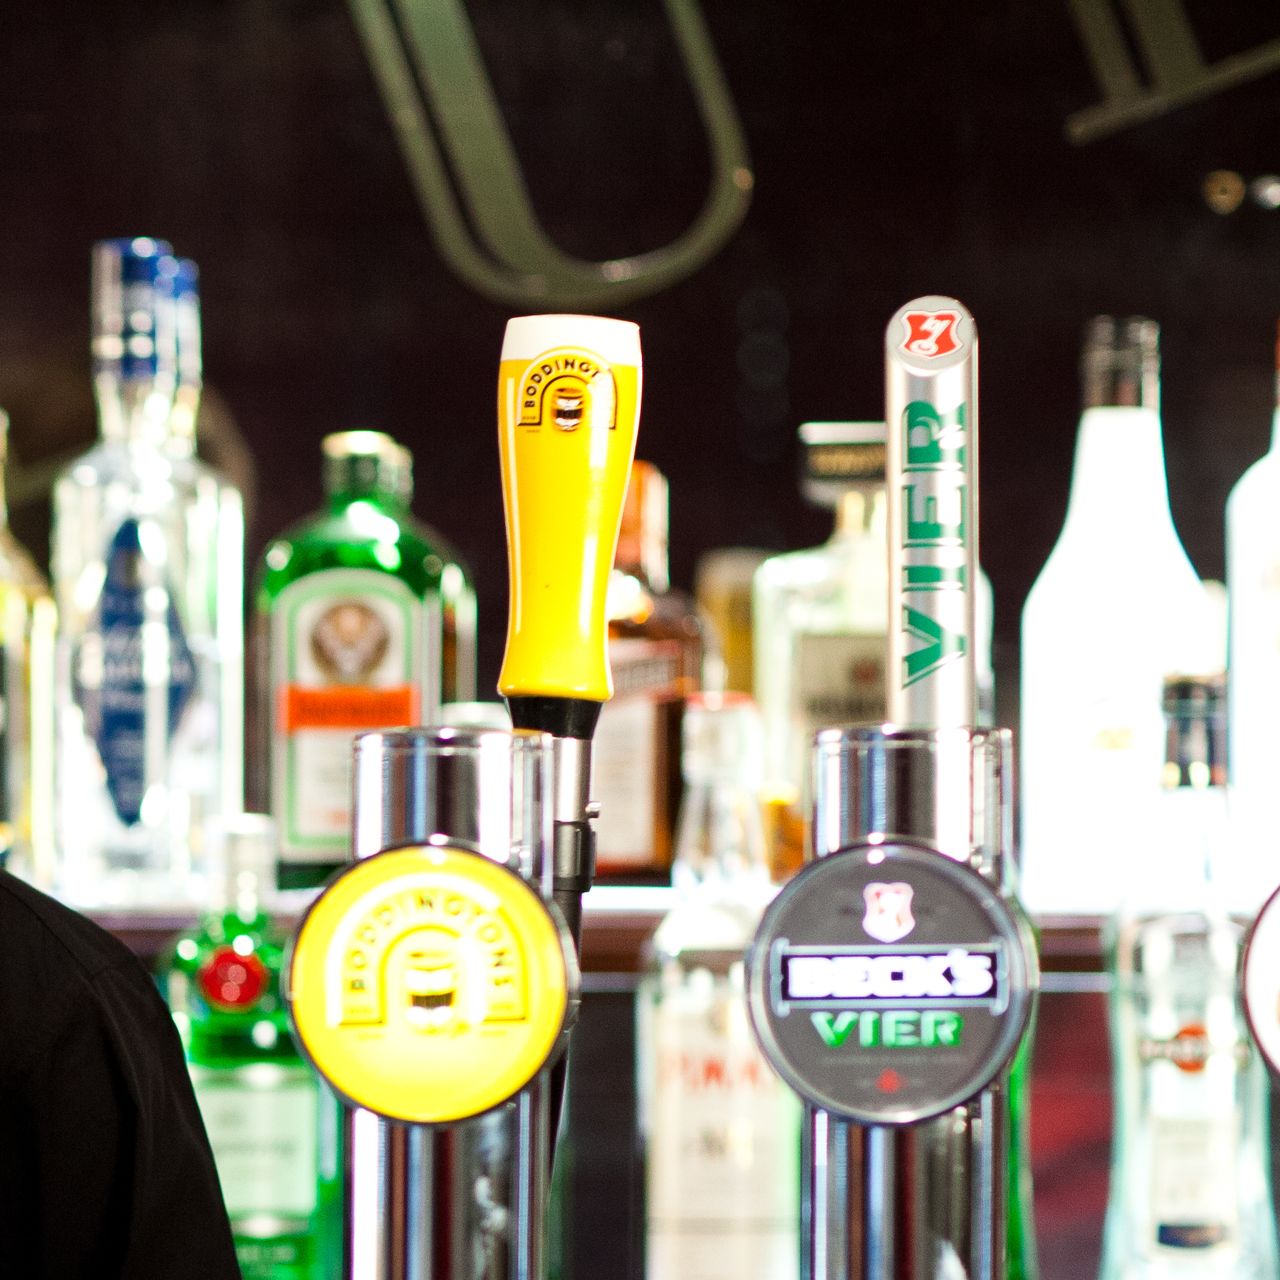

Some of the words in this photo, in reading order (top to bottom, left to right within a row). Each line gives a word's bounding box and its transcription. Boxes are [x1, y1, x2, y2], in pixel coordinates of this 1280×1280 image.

[901, 400, 967, 690] VIER
[787, 947, 995, 999] BECK'S
[810, 1010, 965, 1048] VIER
